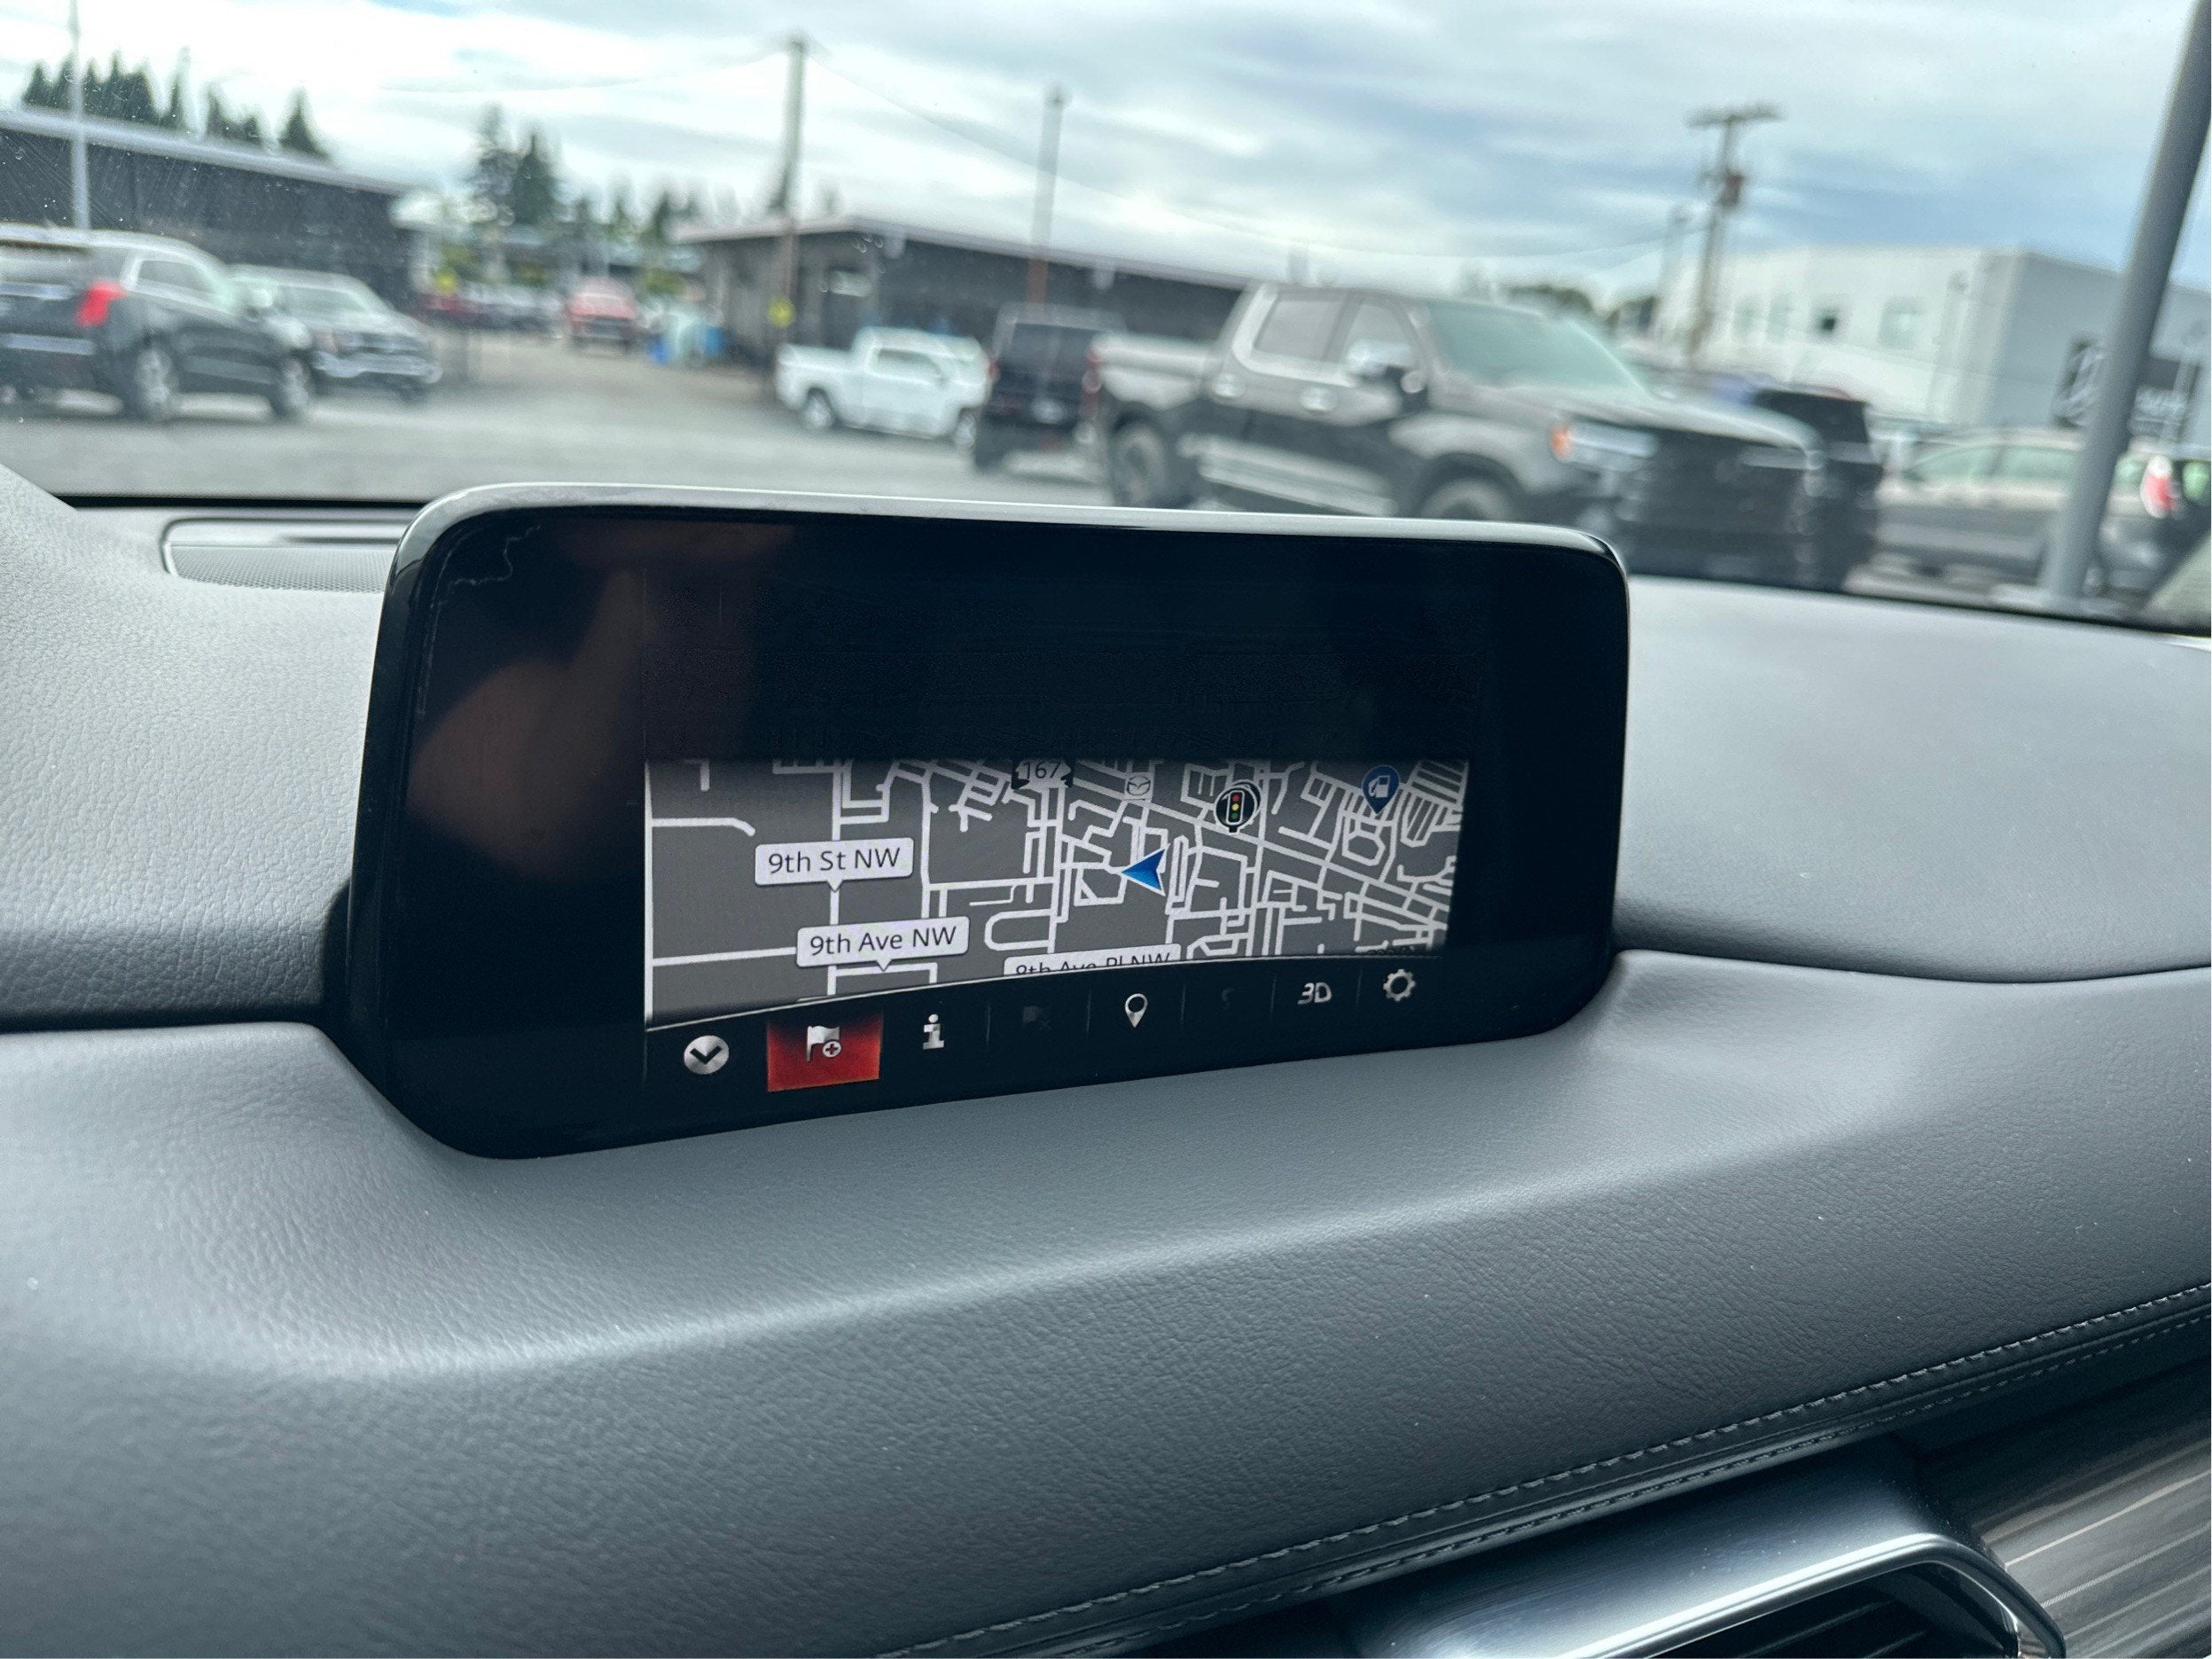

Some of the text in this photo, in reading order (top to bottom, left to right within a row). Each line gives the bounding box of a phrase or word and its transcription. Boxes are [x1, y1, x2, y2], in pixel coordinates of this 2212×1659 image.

[1022, 761, 1062, 779] 167
[769, 847, 901, 874] 9th St NW
[810, 926, 957, 956] 9th Ave NW
[1130, 952, 1170, 965] NW
[1297, 982, 1333, 1006] 3D
